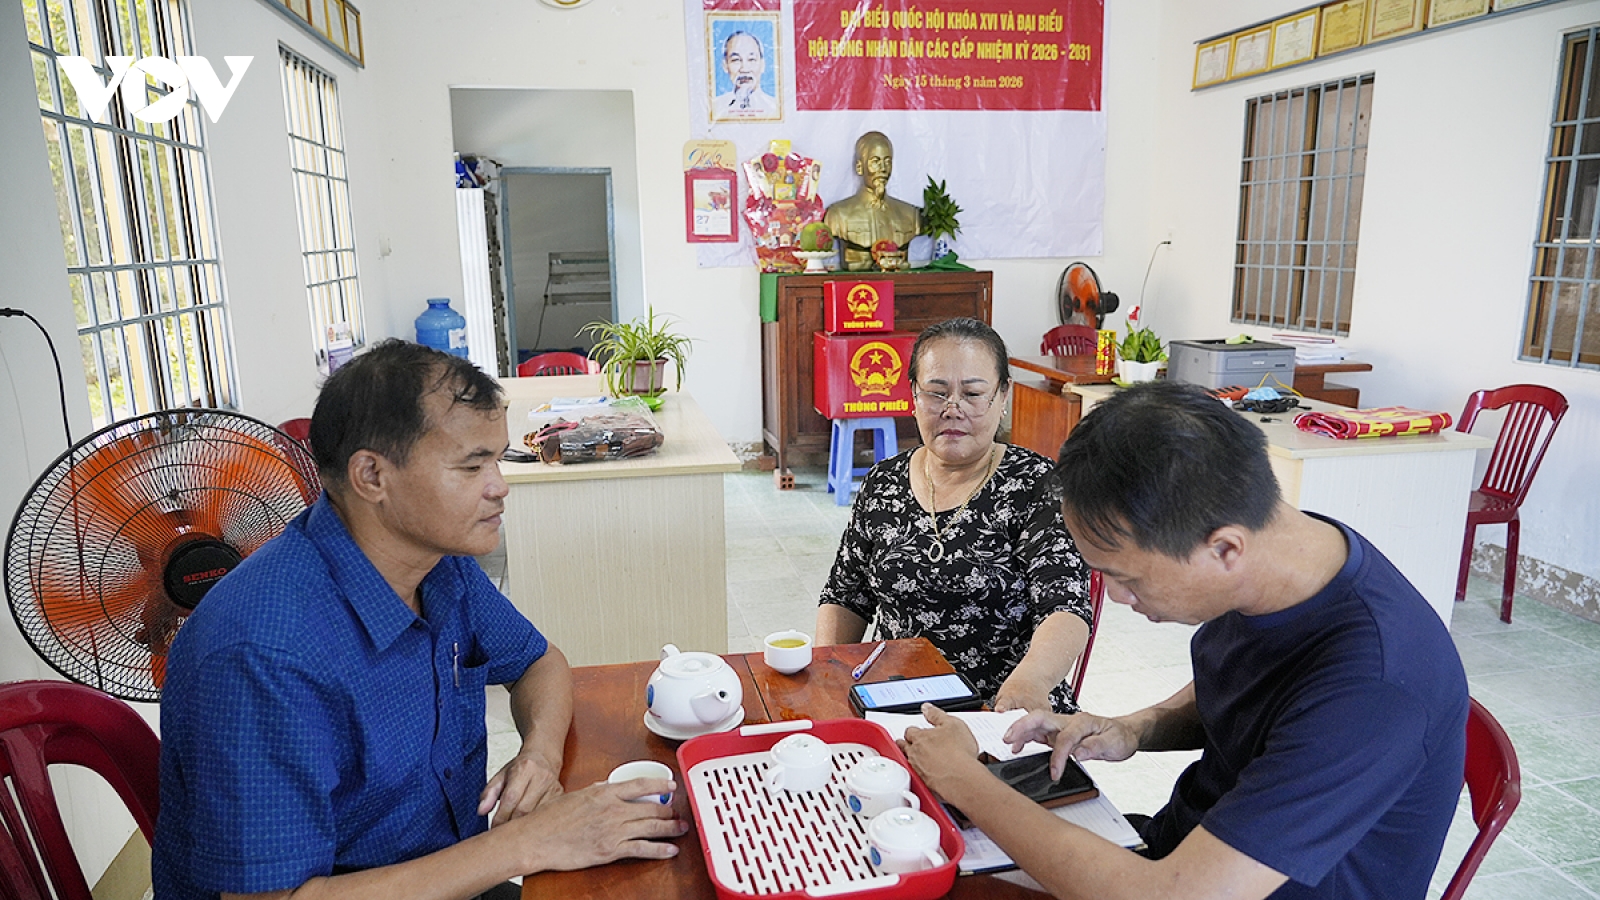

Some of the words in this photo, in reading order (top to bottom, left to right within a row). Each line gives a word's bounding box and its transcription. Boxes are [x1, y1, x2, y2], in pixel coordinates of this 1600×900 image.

[864, 4, 889, 28] BIỂU
[892, 5, 922, 30] QUỐC
[925, 8, 945, 32] HỘI
[947, 9, 977, 30] KHÓA
[980, 12, 998, 31] XVI
[1000, 10, 1015, 31] VÀ
[1017, 14, 1036, 35] ĐẠI
[1038, 8, 1063, 32] BIỂU
[808, 36, 828, 60] HỘI
[866, 36, 897, 57] NHÂN
[900, 37, 924, 58] DÂN
[926, 37, 949, 58] CÁC
[951, 36, 975, 59] CẤP
[977, 39, 1013, 63] NHIỆM
[1031, 43, 1058, 60] 2026
[1068, 43, 1091, 61] 2031
[883, 74, 912, 90] Ngày
[914, 75, 928, 88] 15
[930, 75, 961, 90] tháng
[963, 76, 971, 88] 3
[973, 76, 997, 88] năm
[998, 76, 1024, 88] 2026
[843, 400, 877, 412] THÙNG
[879, 399, 909, 411] PHIẾU
[183, 568, 227, 583] SENKO
